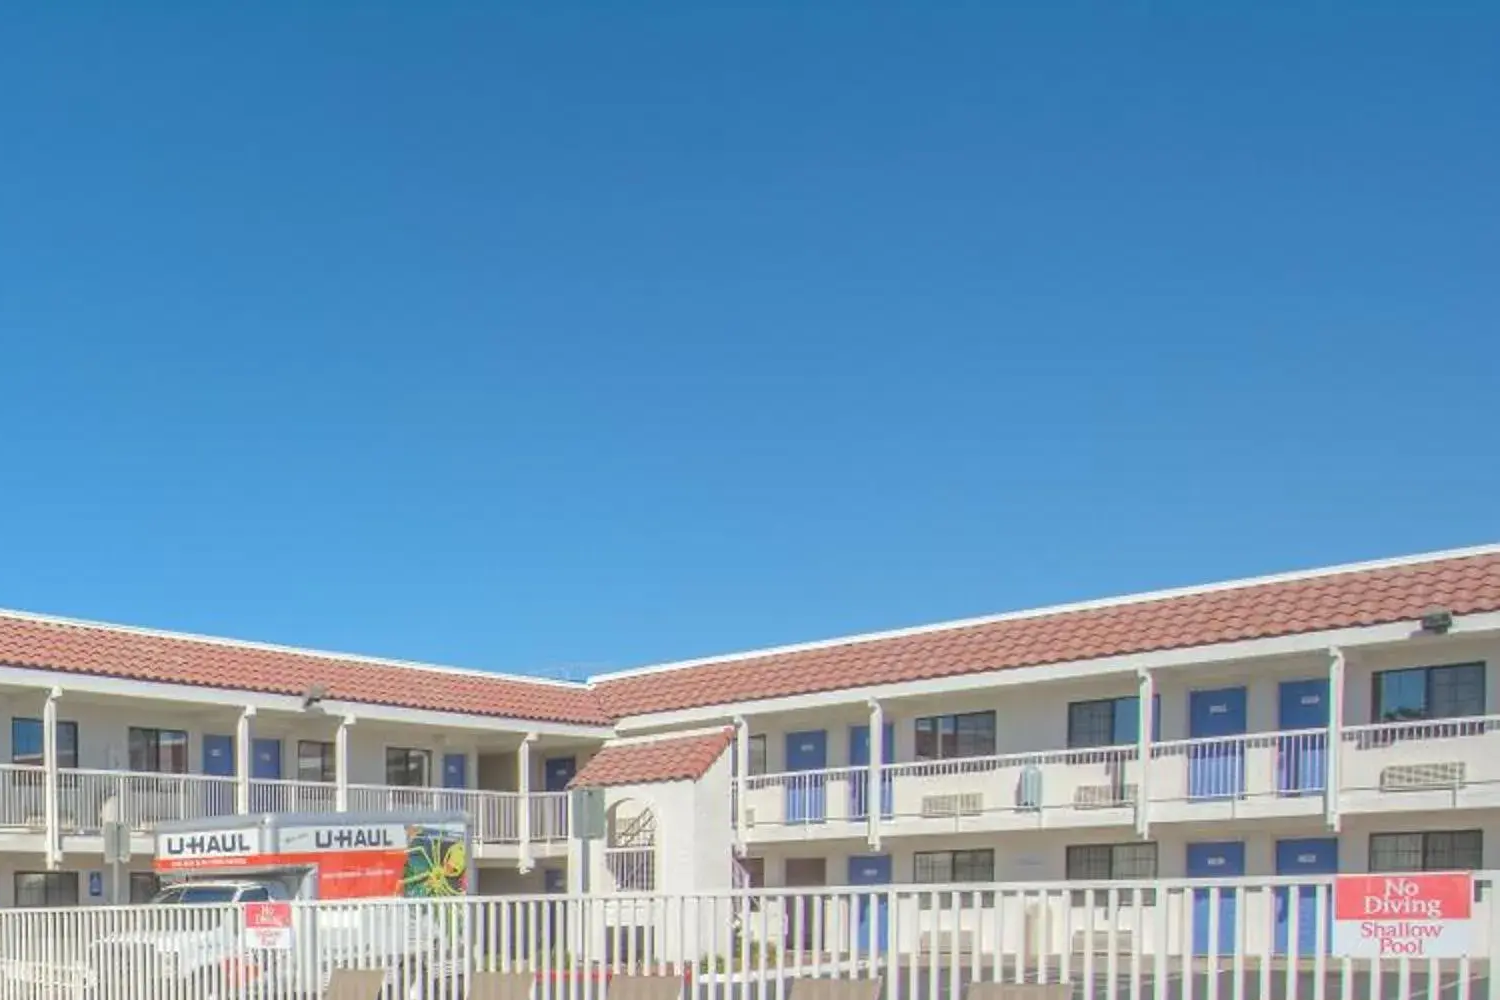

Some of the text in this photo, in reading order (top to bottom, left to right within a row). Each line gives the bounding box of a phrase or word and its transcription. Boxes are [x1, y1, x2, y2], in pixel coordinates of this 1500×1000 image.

[167, 833, 251, 855] U-HAUL
[315, 828, 393, 848] U-HAUL
[1384, 878, 1419, 897] No
[1364, 895, 1442, 919] Diving
[1360, 922, 1444, 938] Shallow
[1379, 937, 1424, 954] Pool
